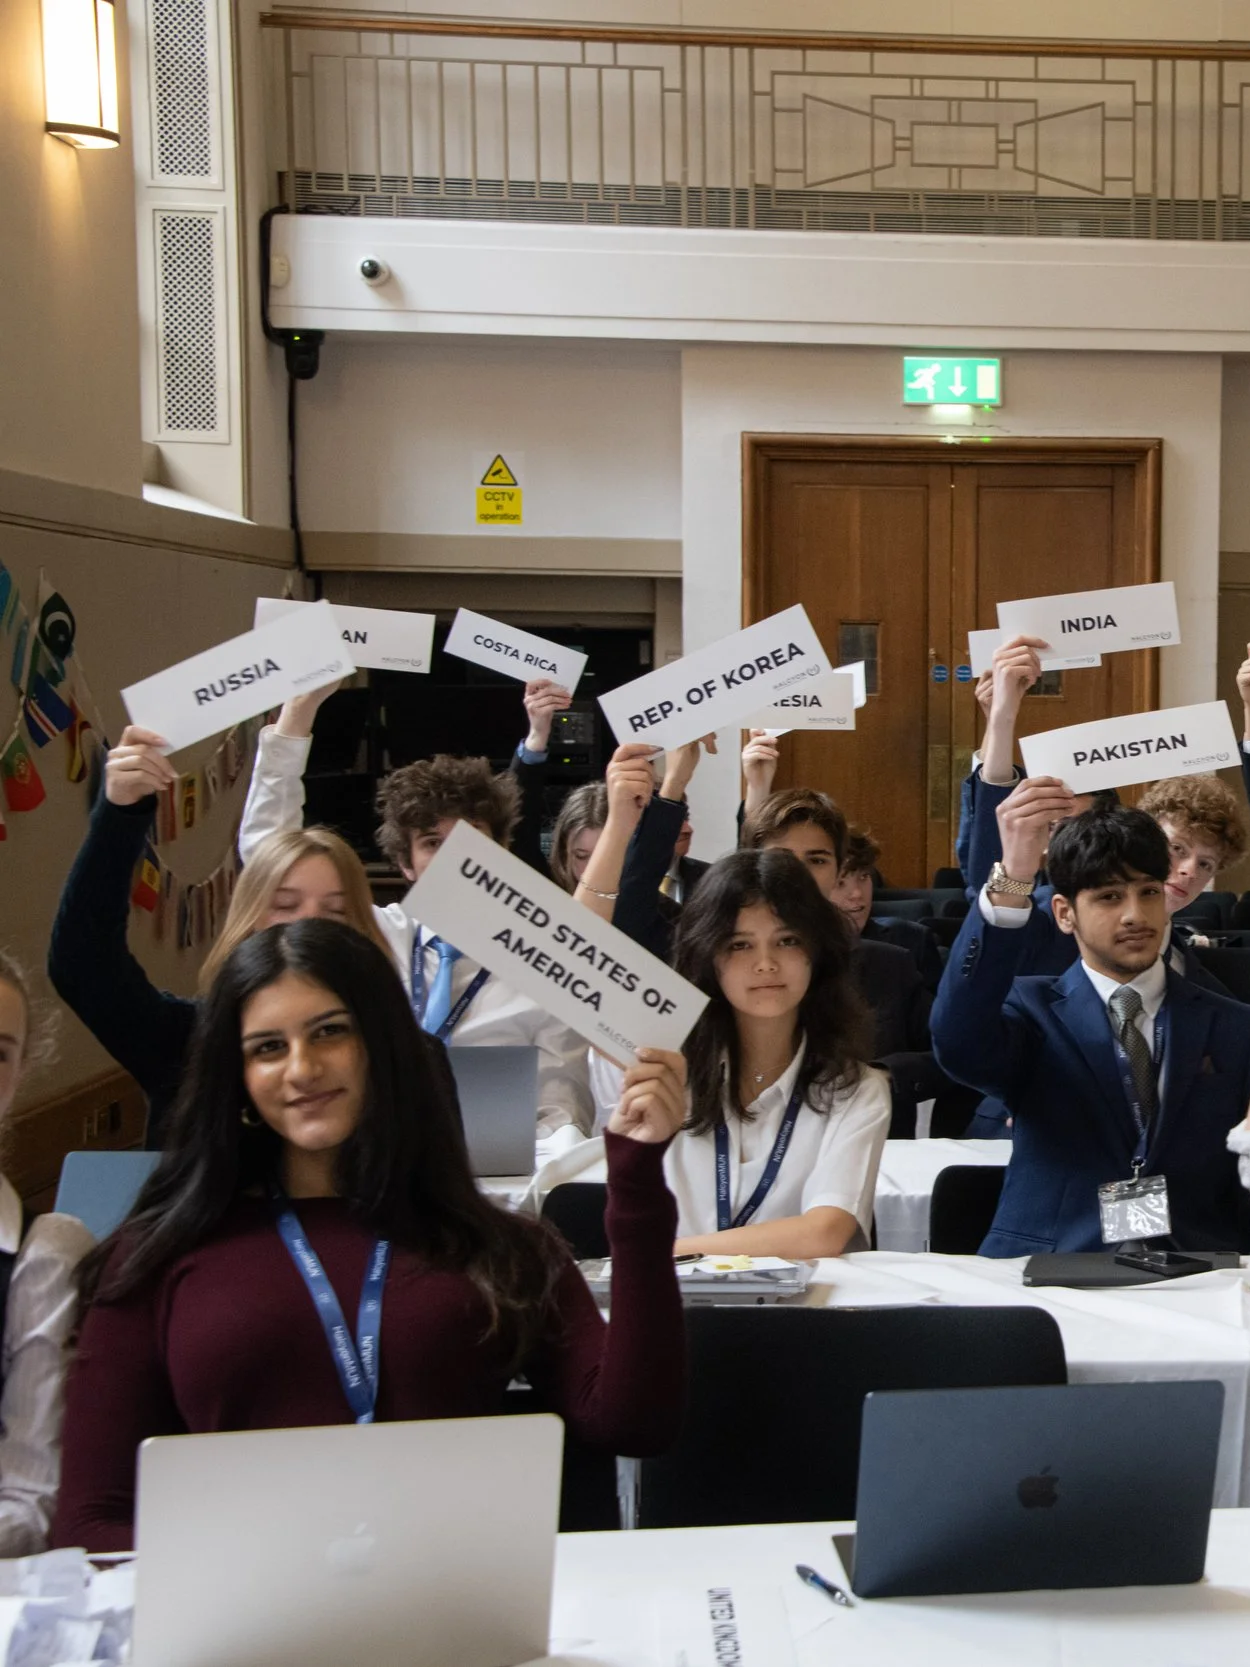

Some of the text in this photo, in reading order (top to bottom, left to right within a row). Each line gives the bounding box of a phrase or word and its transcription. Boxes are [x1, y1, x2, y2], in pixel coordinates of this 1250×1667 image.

[483, 491, 515, 501] CCTV
[479, 513, 520, 522] operation
[1061, 614, 1118, 634] INDIA
[473, 634, 558, 674] COSTA RICA
[194, 656, 282, 706] RUSSIA
[628, 641, 806, 733] REP. OF KOREA
[772, 694, 823, 708] ESIA
[1073, 733, 1188, 767] PAKISTAN
[459, 857, 678, 1018] UNITED STATES OF
[491, 927, 604, 1013] AMERICA
[718, 1153, 727, 1202] HalcyonMUN
[331, 1325, 361, 1389] HalcyonMUN
[707, 1587, 735, 1620] UNITED
